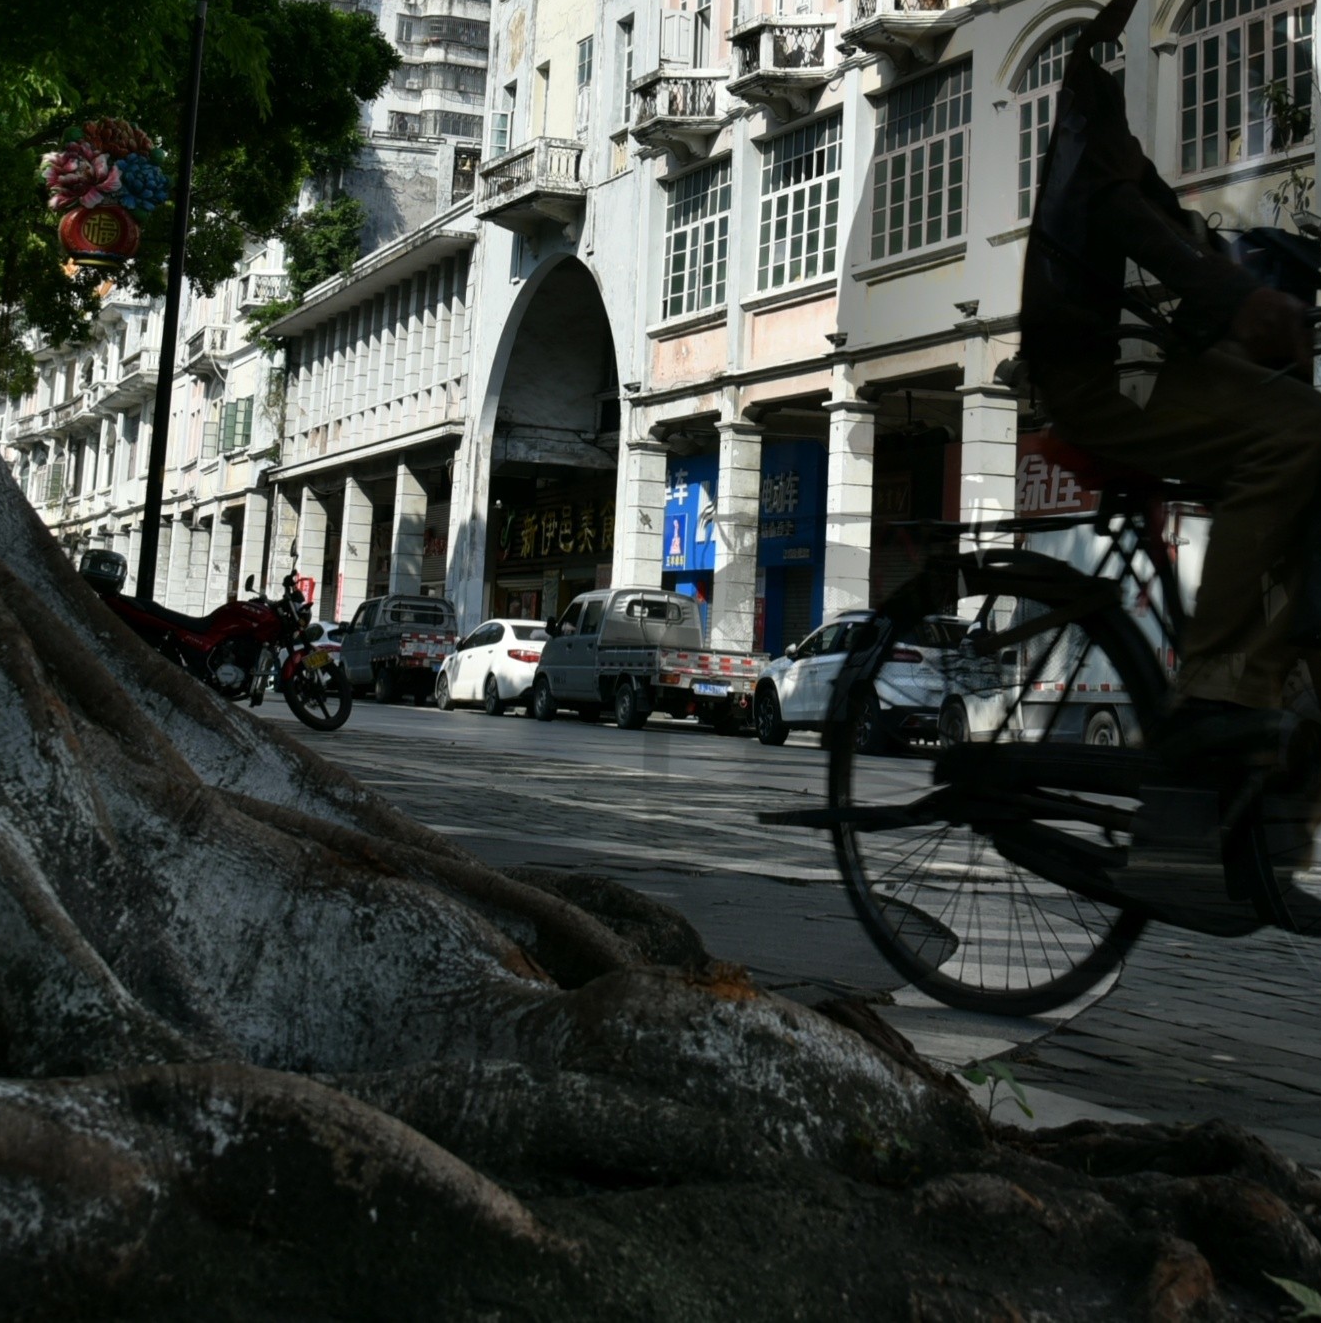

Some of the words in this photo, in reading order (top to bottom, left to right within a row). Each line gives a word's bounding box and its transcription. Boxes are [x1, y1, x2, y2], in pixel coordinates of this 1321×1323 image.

[84, 213, 118, 245] 福
[761, 470, 800, 514] 电动车
